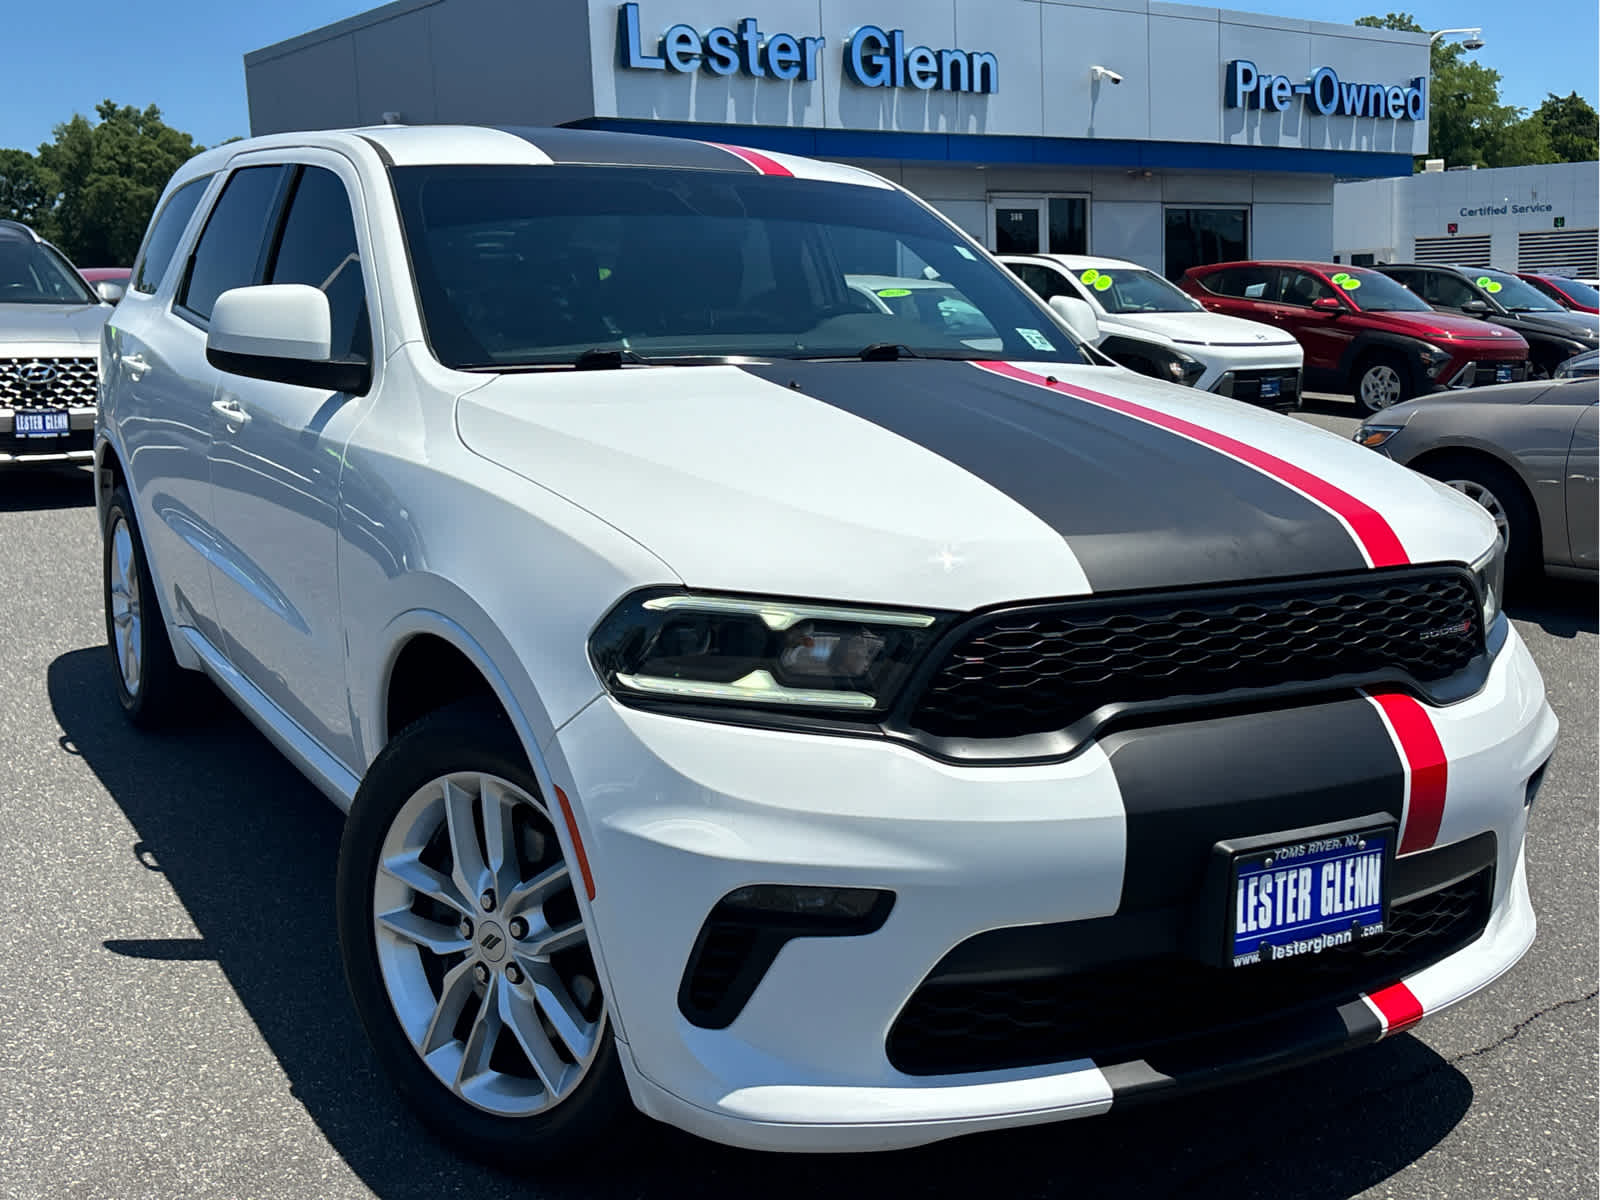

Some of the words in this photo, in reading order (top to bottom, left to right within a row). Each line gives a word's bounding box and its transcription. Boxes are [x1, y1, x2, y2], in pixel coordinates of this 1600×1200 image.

[620, 3, 825, 81] Lester
[845, 24, 1000, 95] Glenn
[1227, 60, 1426, 121] Pre-Owned
[1460, 205, 1508, 217] Certified
[1511, 203, 1552, 214] Service
[16, 414, 43, 431] LESTER
[1274, 847, 1305, 861] TOMS
[1345, 835, 1360, 848] NJ
[1236, 867, 1312, 934] LESTER
[1320, 853, 1382, 916] GLENN
